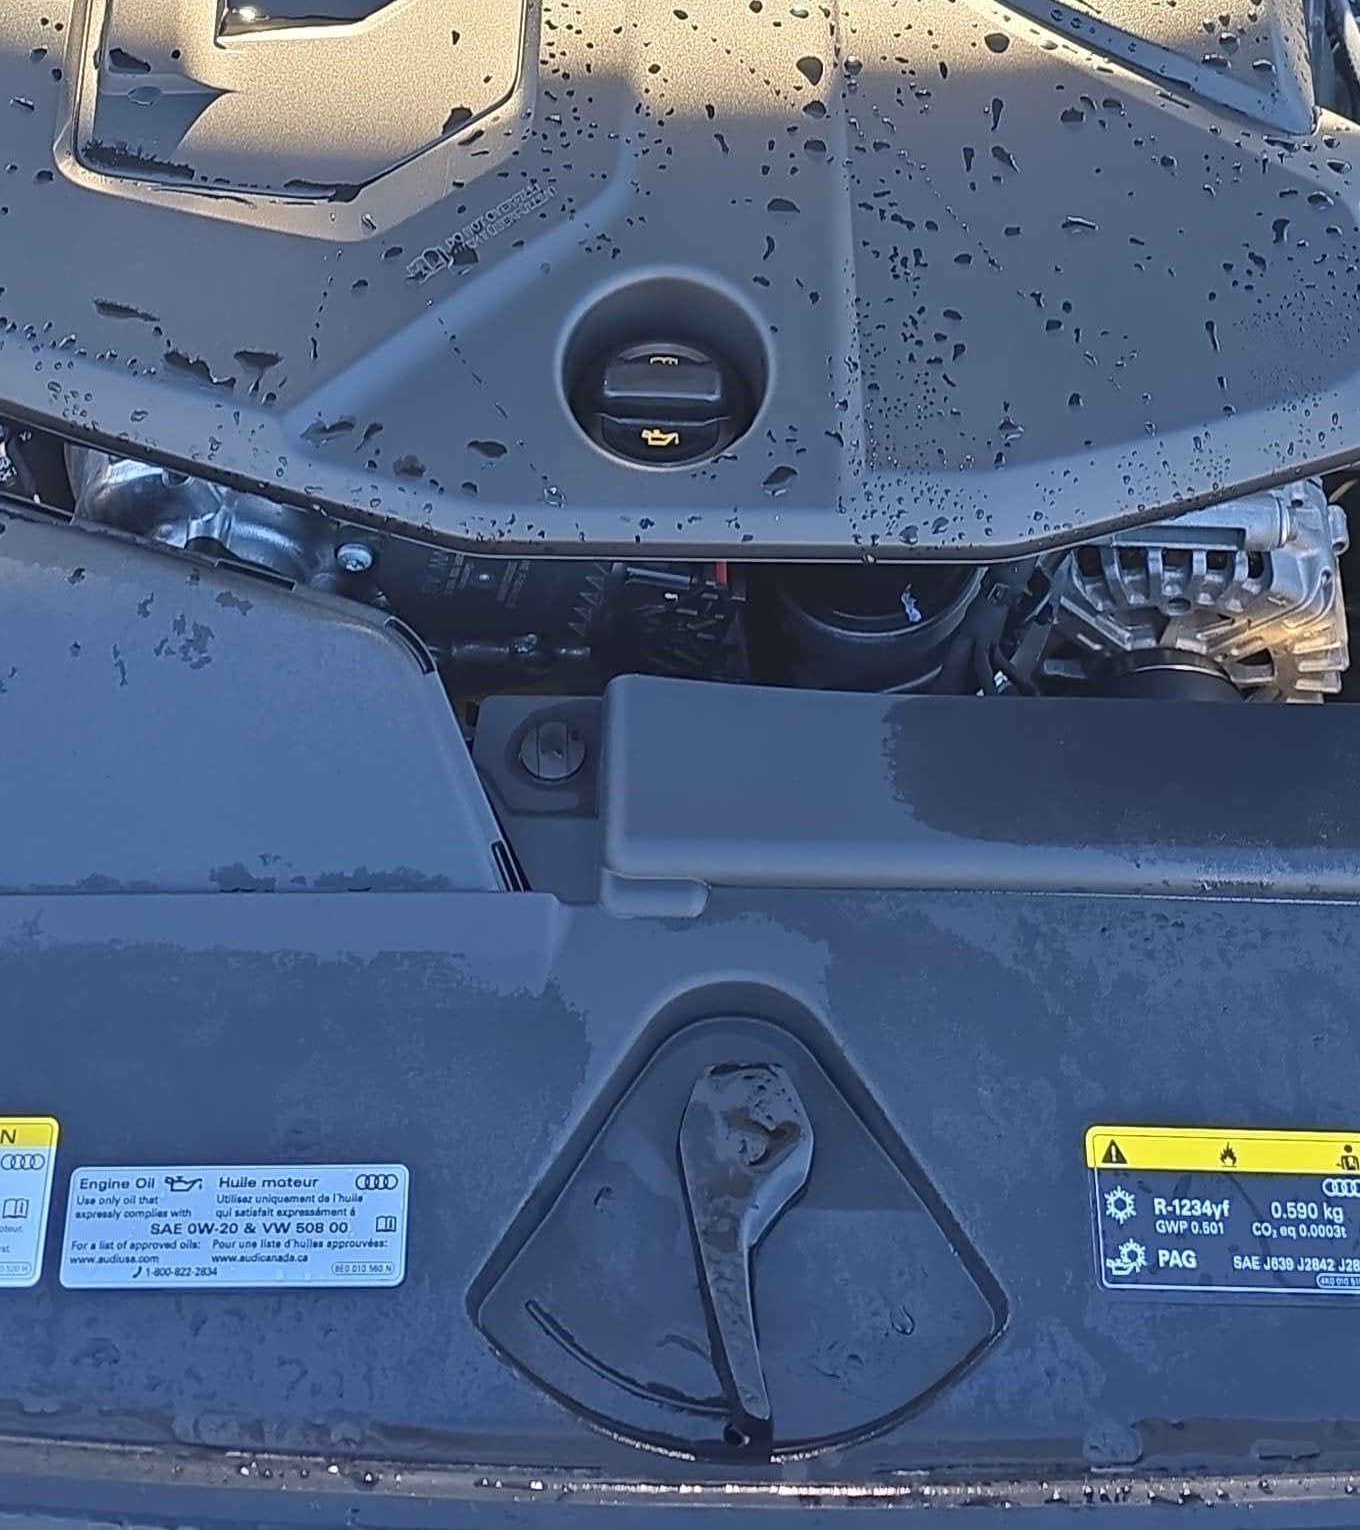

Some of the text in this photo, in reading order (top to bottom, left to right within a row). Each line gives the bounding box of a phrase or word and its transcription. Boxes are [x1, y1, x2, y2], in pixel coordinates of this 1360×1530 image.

[80, 1177, 156, 1192] Engine Oil
[219, 1177, 320, 1189] Huile moteur
[76, 1195, 159, 1207] Use only oil that
[216, 1193, 253, 1204] Utilisez
[255, 1193, 316, 1206] uniquement
[318, 1192, 330, 1204] de
[75, 1207, 192, 1221] expressly complies with
[215, 1207, 232, 1220] qui
[235, 1207, 274, 1218] satisfait
[1153, 1197, 1230, 1221] R-1234yf
[1271, 1201, 1345, 1224] 0.590 kg
[150, 1221, 349, 1235] SAE 0W-20 & VW 508 00
[1155, 1219, 1225, 1235] GWP 0.501
[1280, 1226, 1298, 1240] eq
[1299, 1223, 1348, 1239] 0.0003t
[71, 1239, 201, 1252] For a list of approved oils:
[212, 1239, 236, 1250] Pour
[239, 1240, 258, 1250] une
[260, 1238, 282, 1250] liste
[326, 1237, 389, 1251] approuvées:
[70, 1253, 160, 1265] www.audiusa.com
[211, 1252, 309, 1263] www.audicanada.ca
[1158, 1249, 1198, 1269] PAG
[1233, 1255, 1261, 1271] SAE
[1297, 1256, 1336, 1272] J2842
[146, 1266, 218, 1277] 1-800-822-2834
